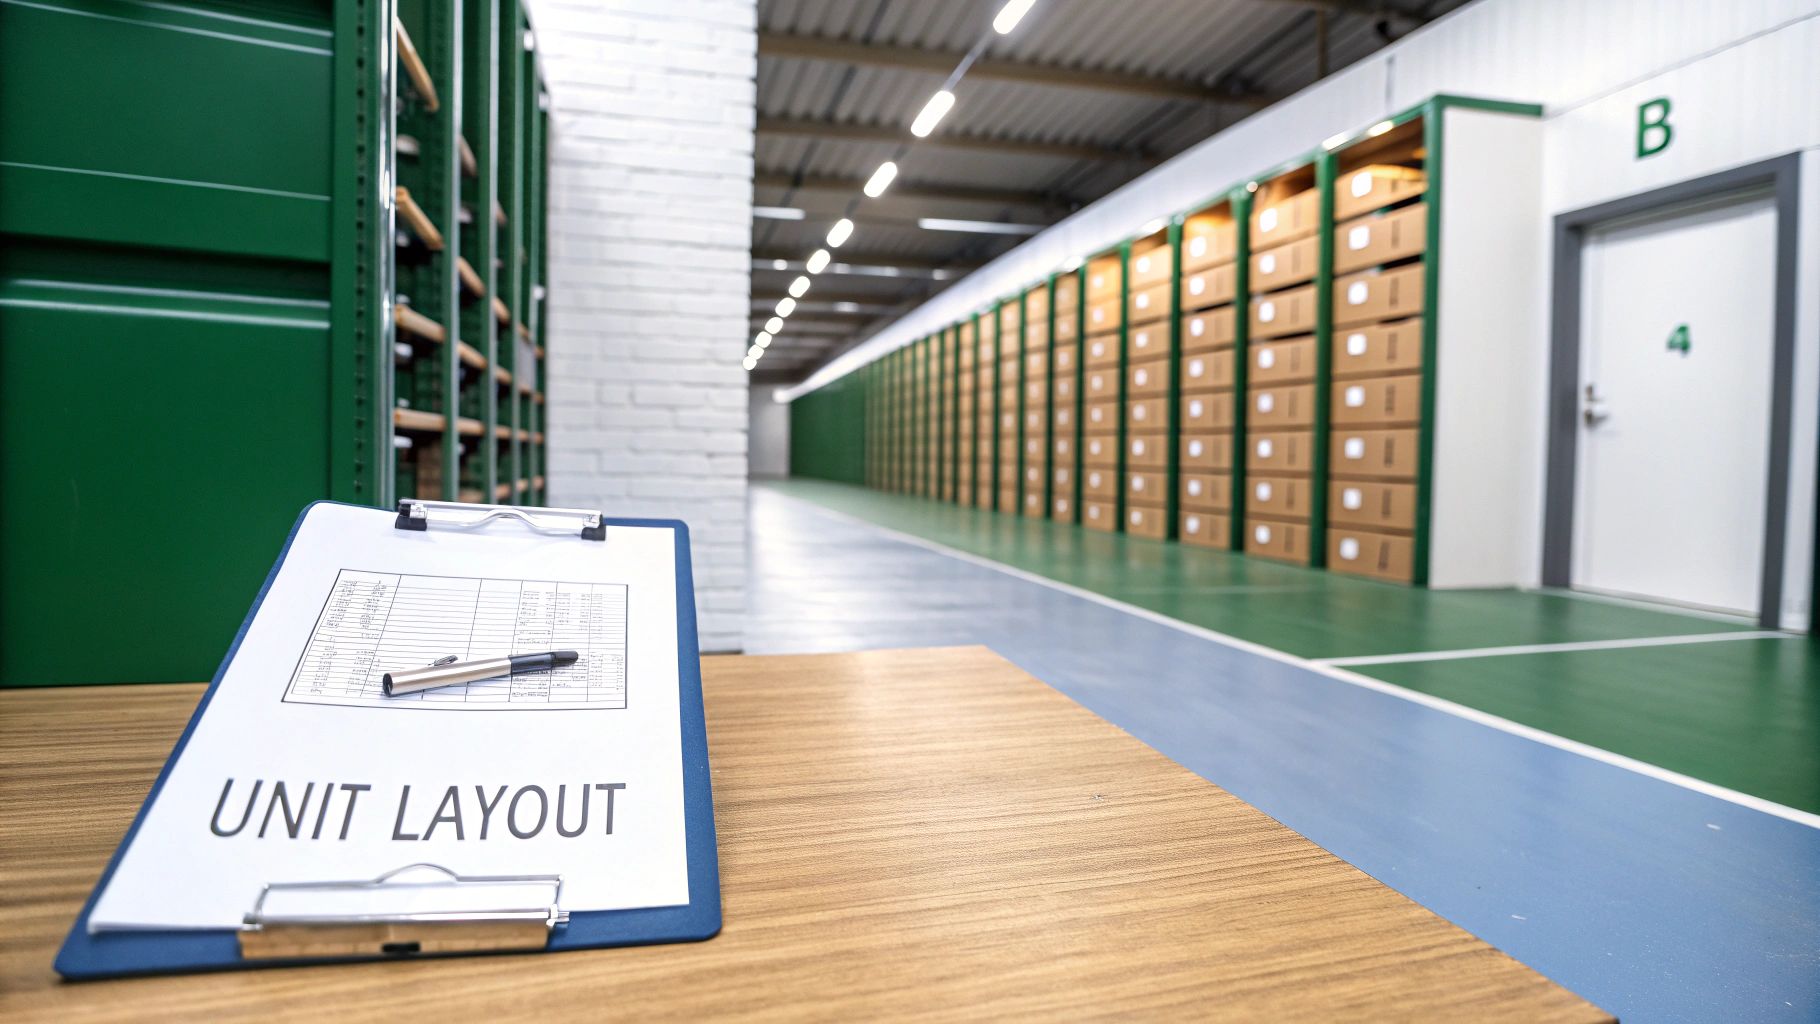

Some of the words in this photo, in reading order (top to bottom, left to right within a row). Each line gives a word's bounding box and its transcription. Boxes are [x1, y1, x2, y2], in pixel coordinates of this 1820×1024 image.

[1636, 97, 1673, 159] B
[1666, 324, 1692, 356] 4
[209, 777, 372, 840] UNIT
[391, 783, 627, 841] LAYOUT
